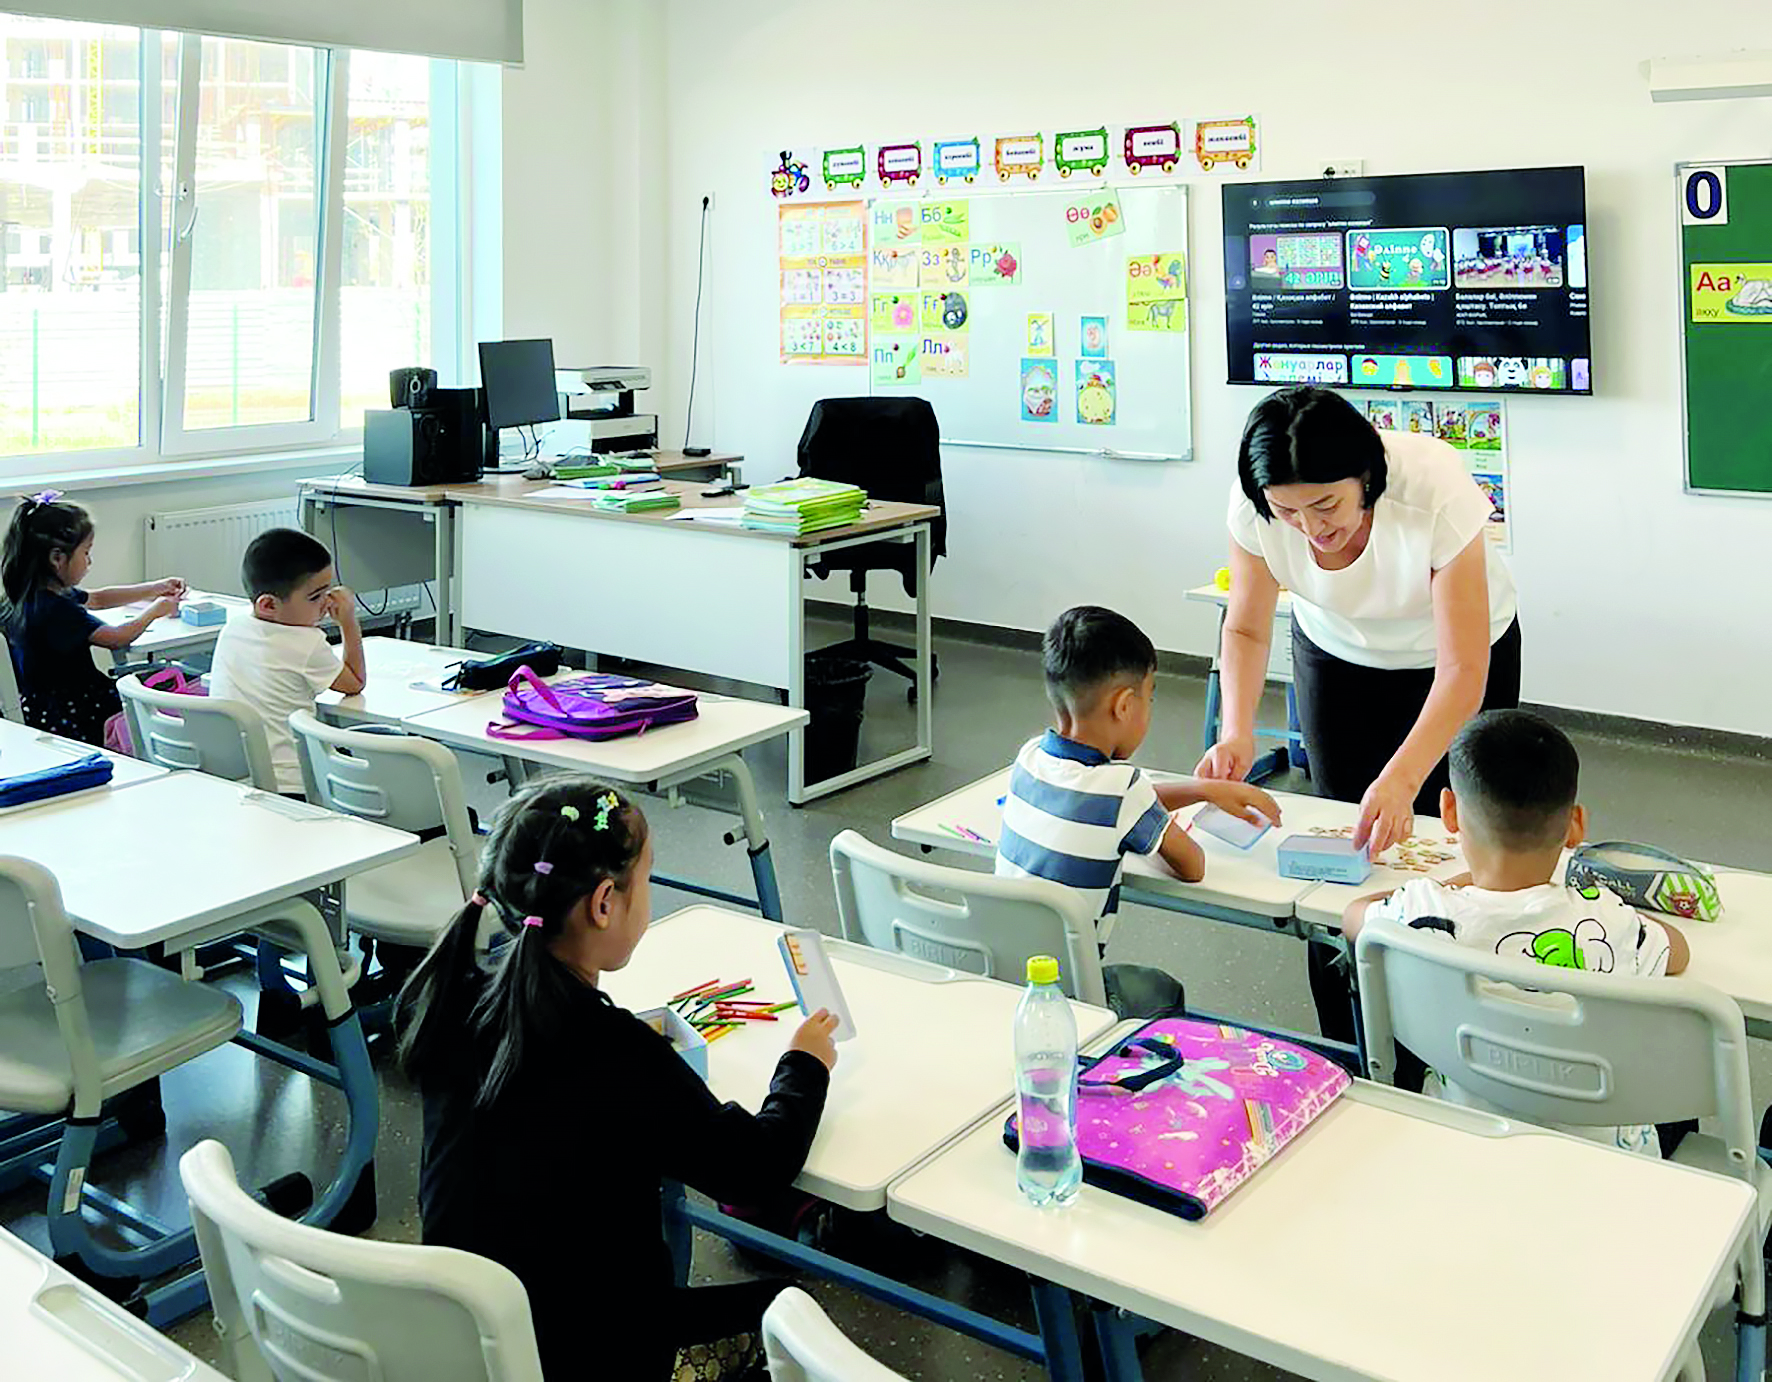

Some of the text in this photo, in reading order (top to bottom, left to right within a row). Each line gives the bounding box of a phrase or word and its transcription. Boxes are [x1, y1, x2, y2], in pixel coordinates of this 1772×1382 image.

[875, 211, 893, 225] Нн
[921, 206, 942, 223] Бб
[922, 250, 940, 266] Зз
[971, 249, 991, 268] Рр
[1129, 261, 1152, 277] Әә
[1696, 271, 1731, 291] Аа
[922, 339, 943, 354] Лл
[875, 348, 893, 363] Пп
